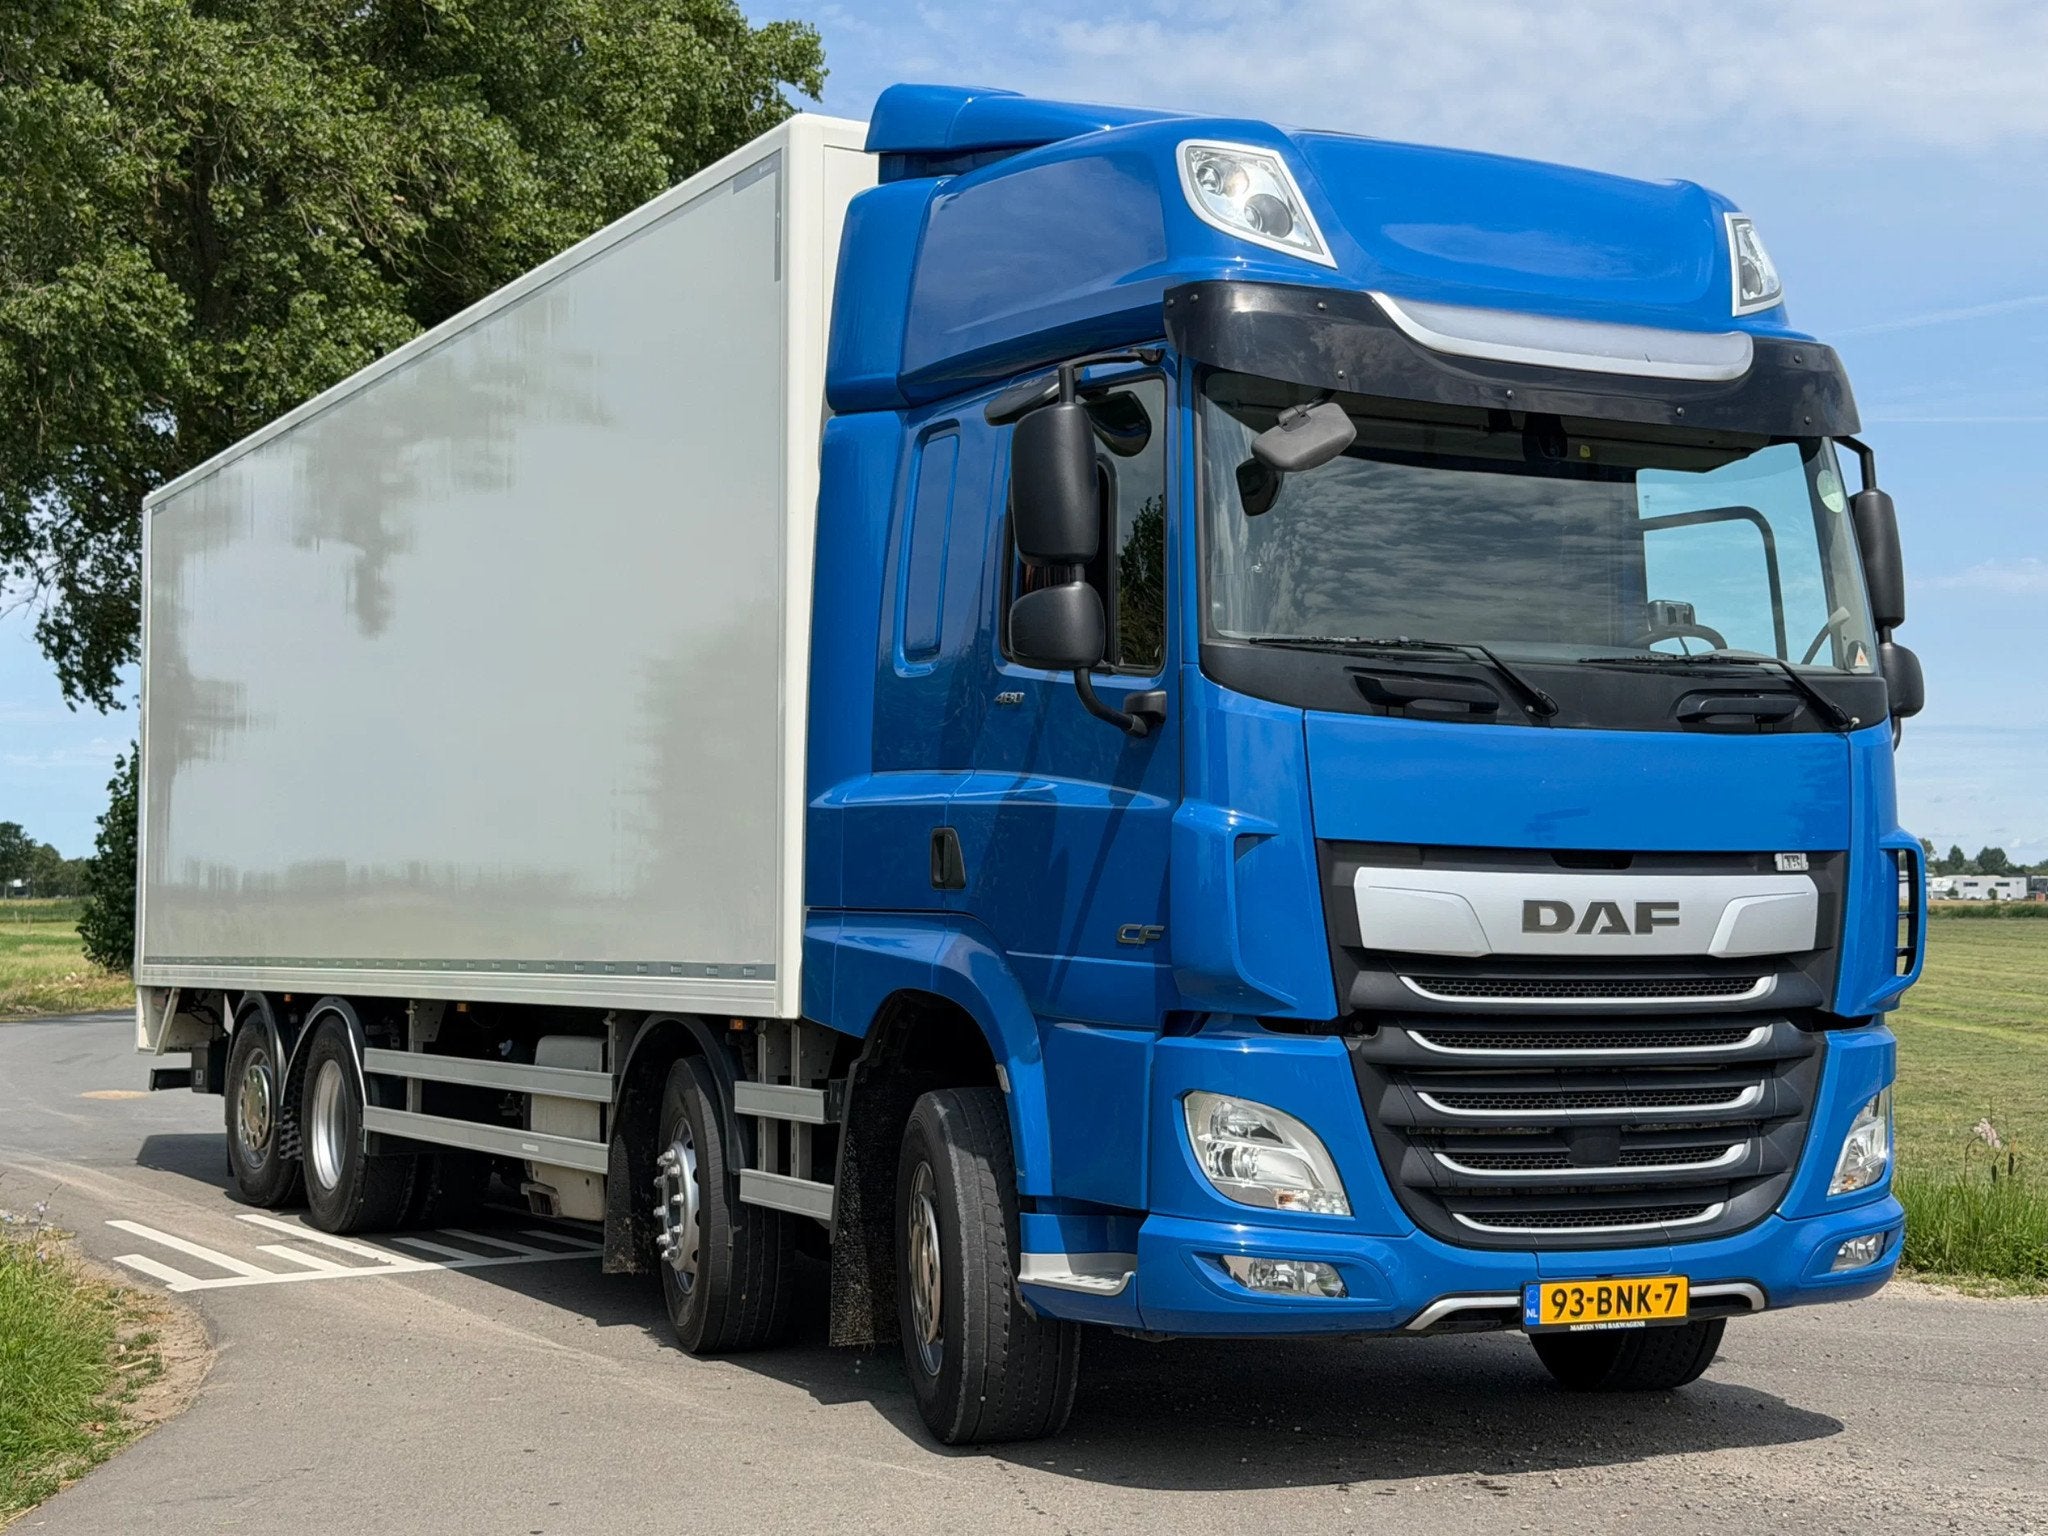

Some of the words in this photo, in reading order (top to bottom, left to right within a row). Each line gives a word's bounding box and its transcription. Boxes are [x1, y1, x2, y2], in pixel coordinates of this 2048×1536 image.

[1522, 900, 1679, 935] DAF
[1117, 923, 1165, 944] CF
[1551, 1283, 1678, 1320] 93-BNK-7
[1526, 1308, 1538, 1318] NL
[1608, 1321, 1646, 1329] BAKWAGENS
